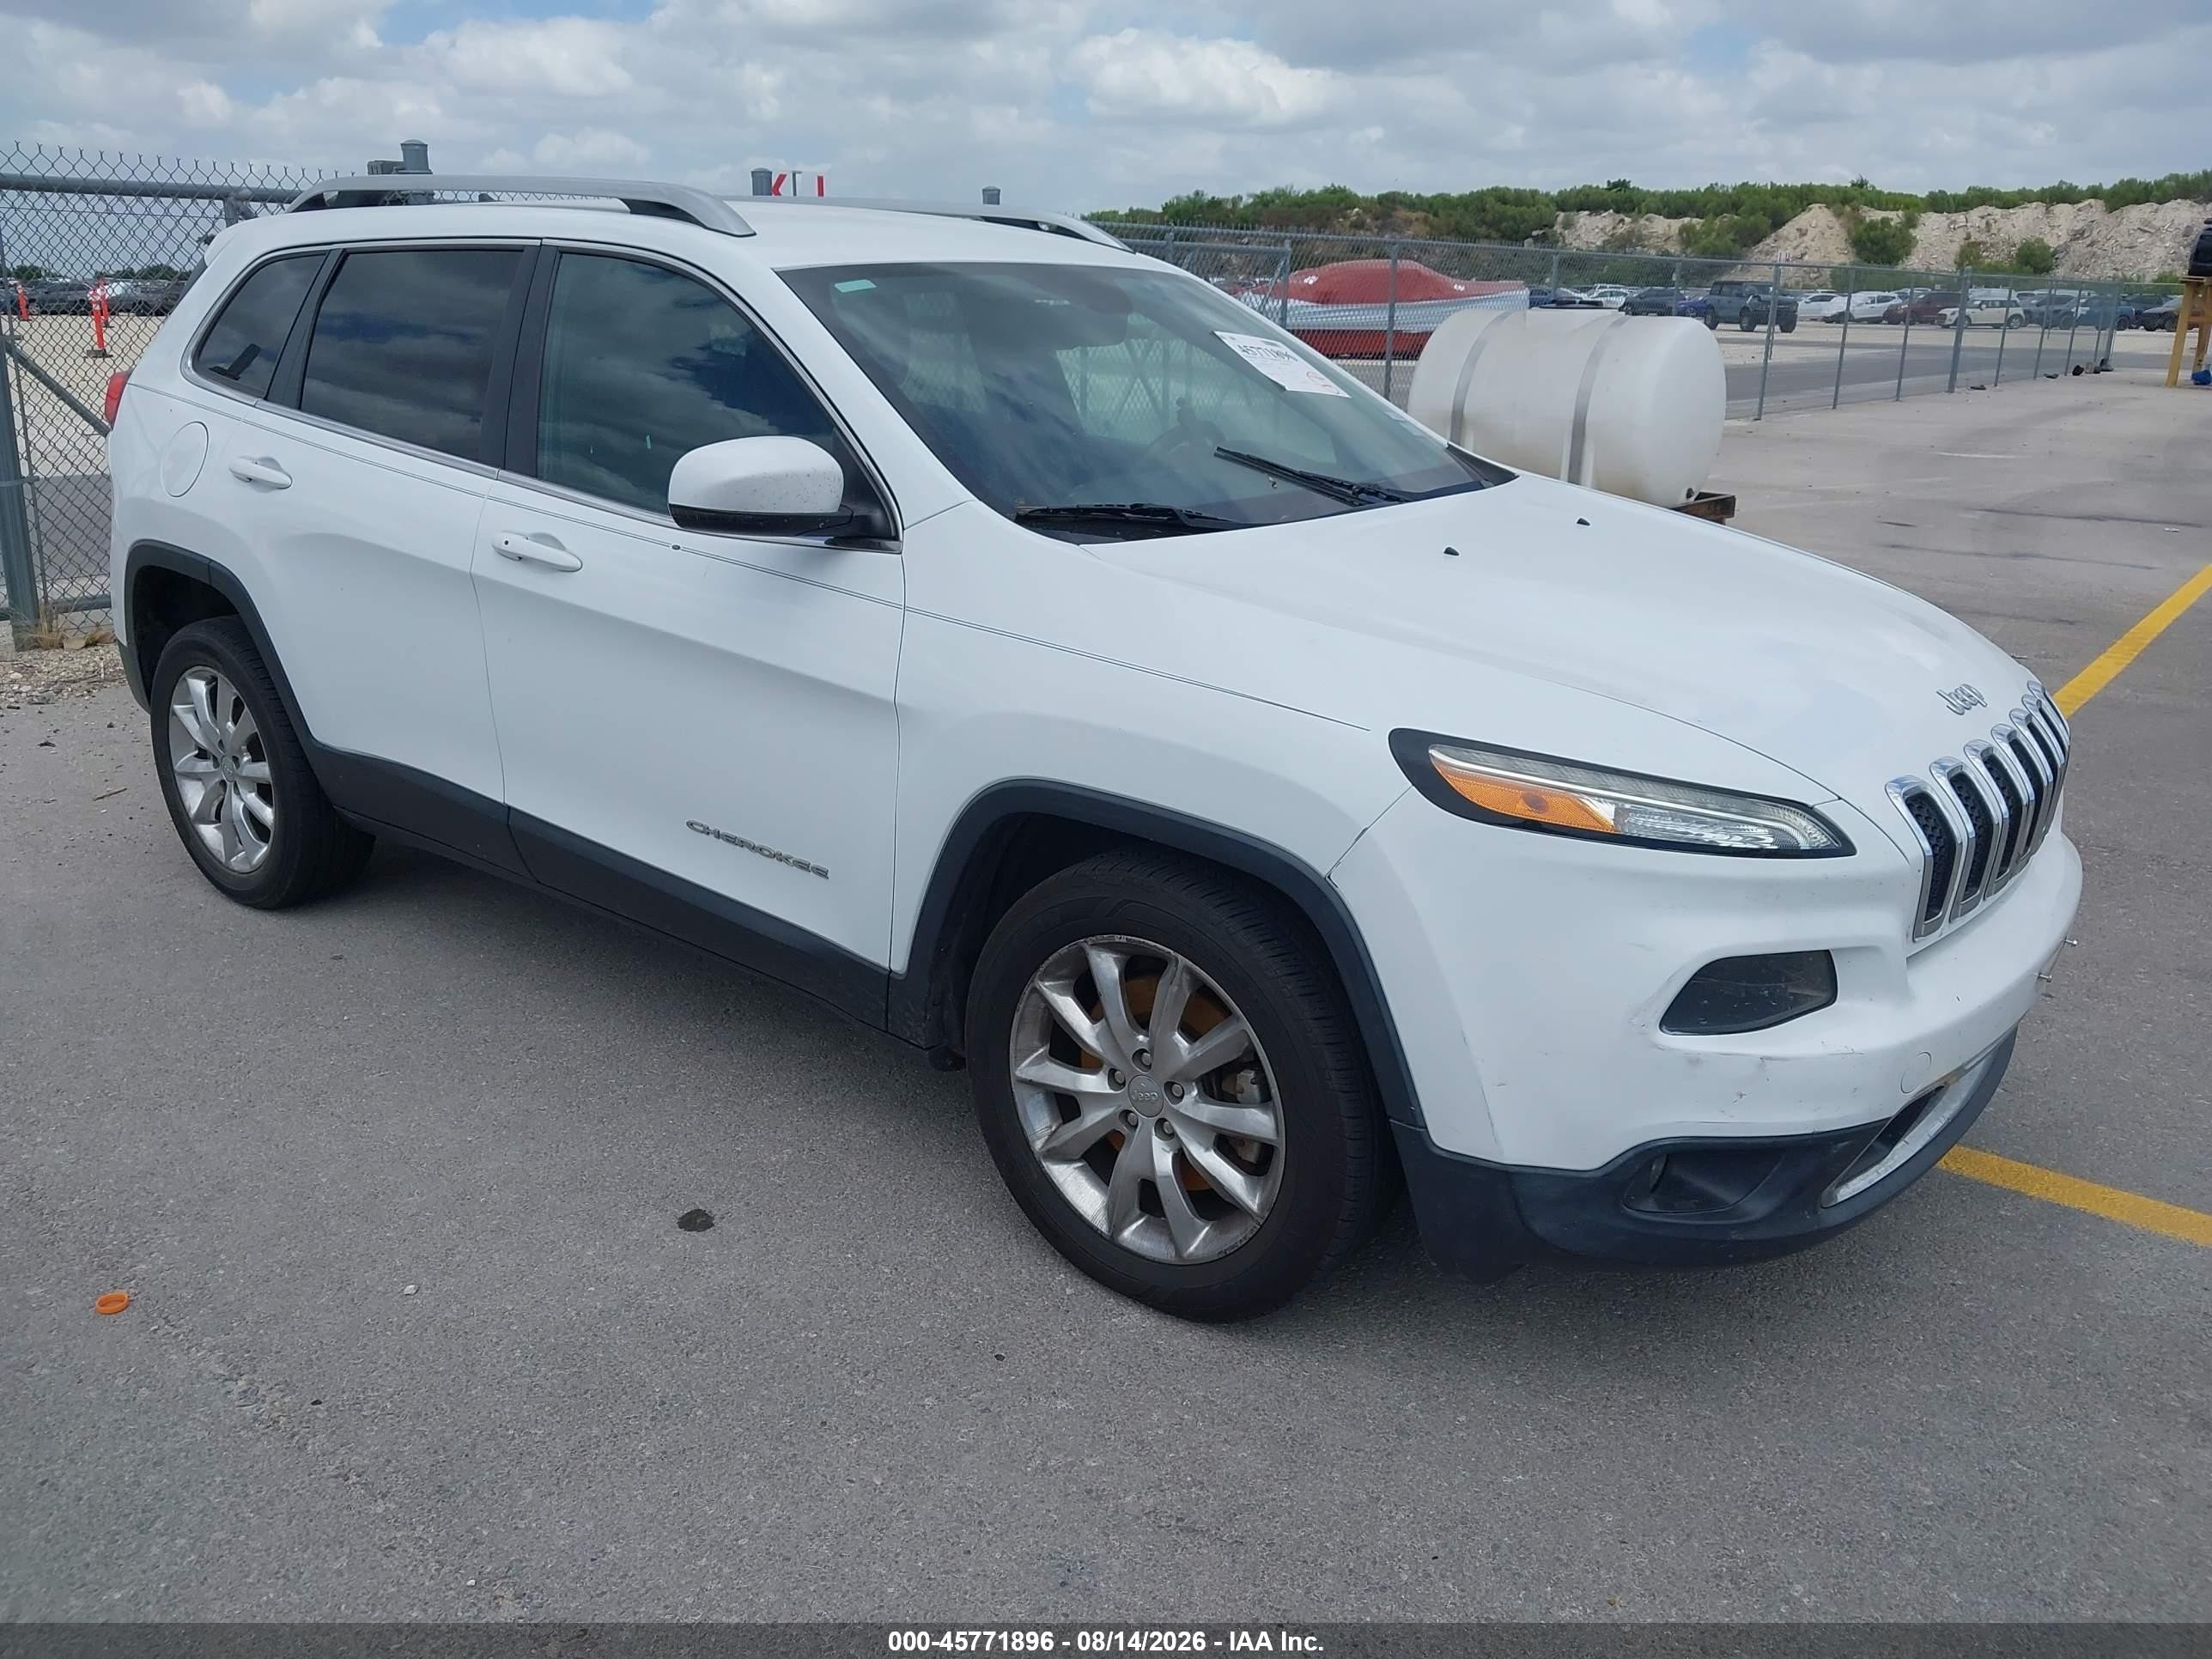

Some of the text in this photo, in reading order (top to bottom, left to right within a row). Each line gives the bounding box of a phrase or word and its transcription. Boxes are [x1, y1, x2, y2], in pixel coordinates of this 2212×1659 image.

[1936, 684, 1988, 716] Jeep
[685, 819, 830, 880] CHEROKEE
[1132, 1090, 1158, 1102] Jeep
